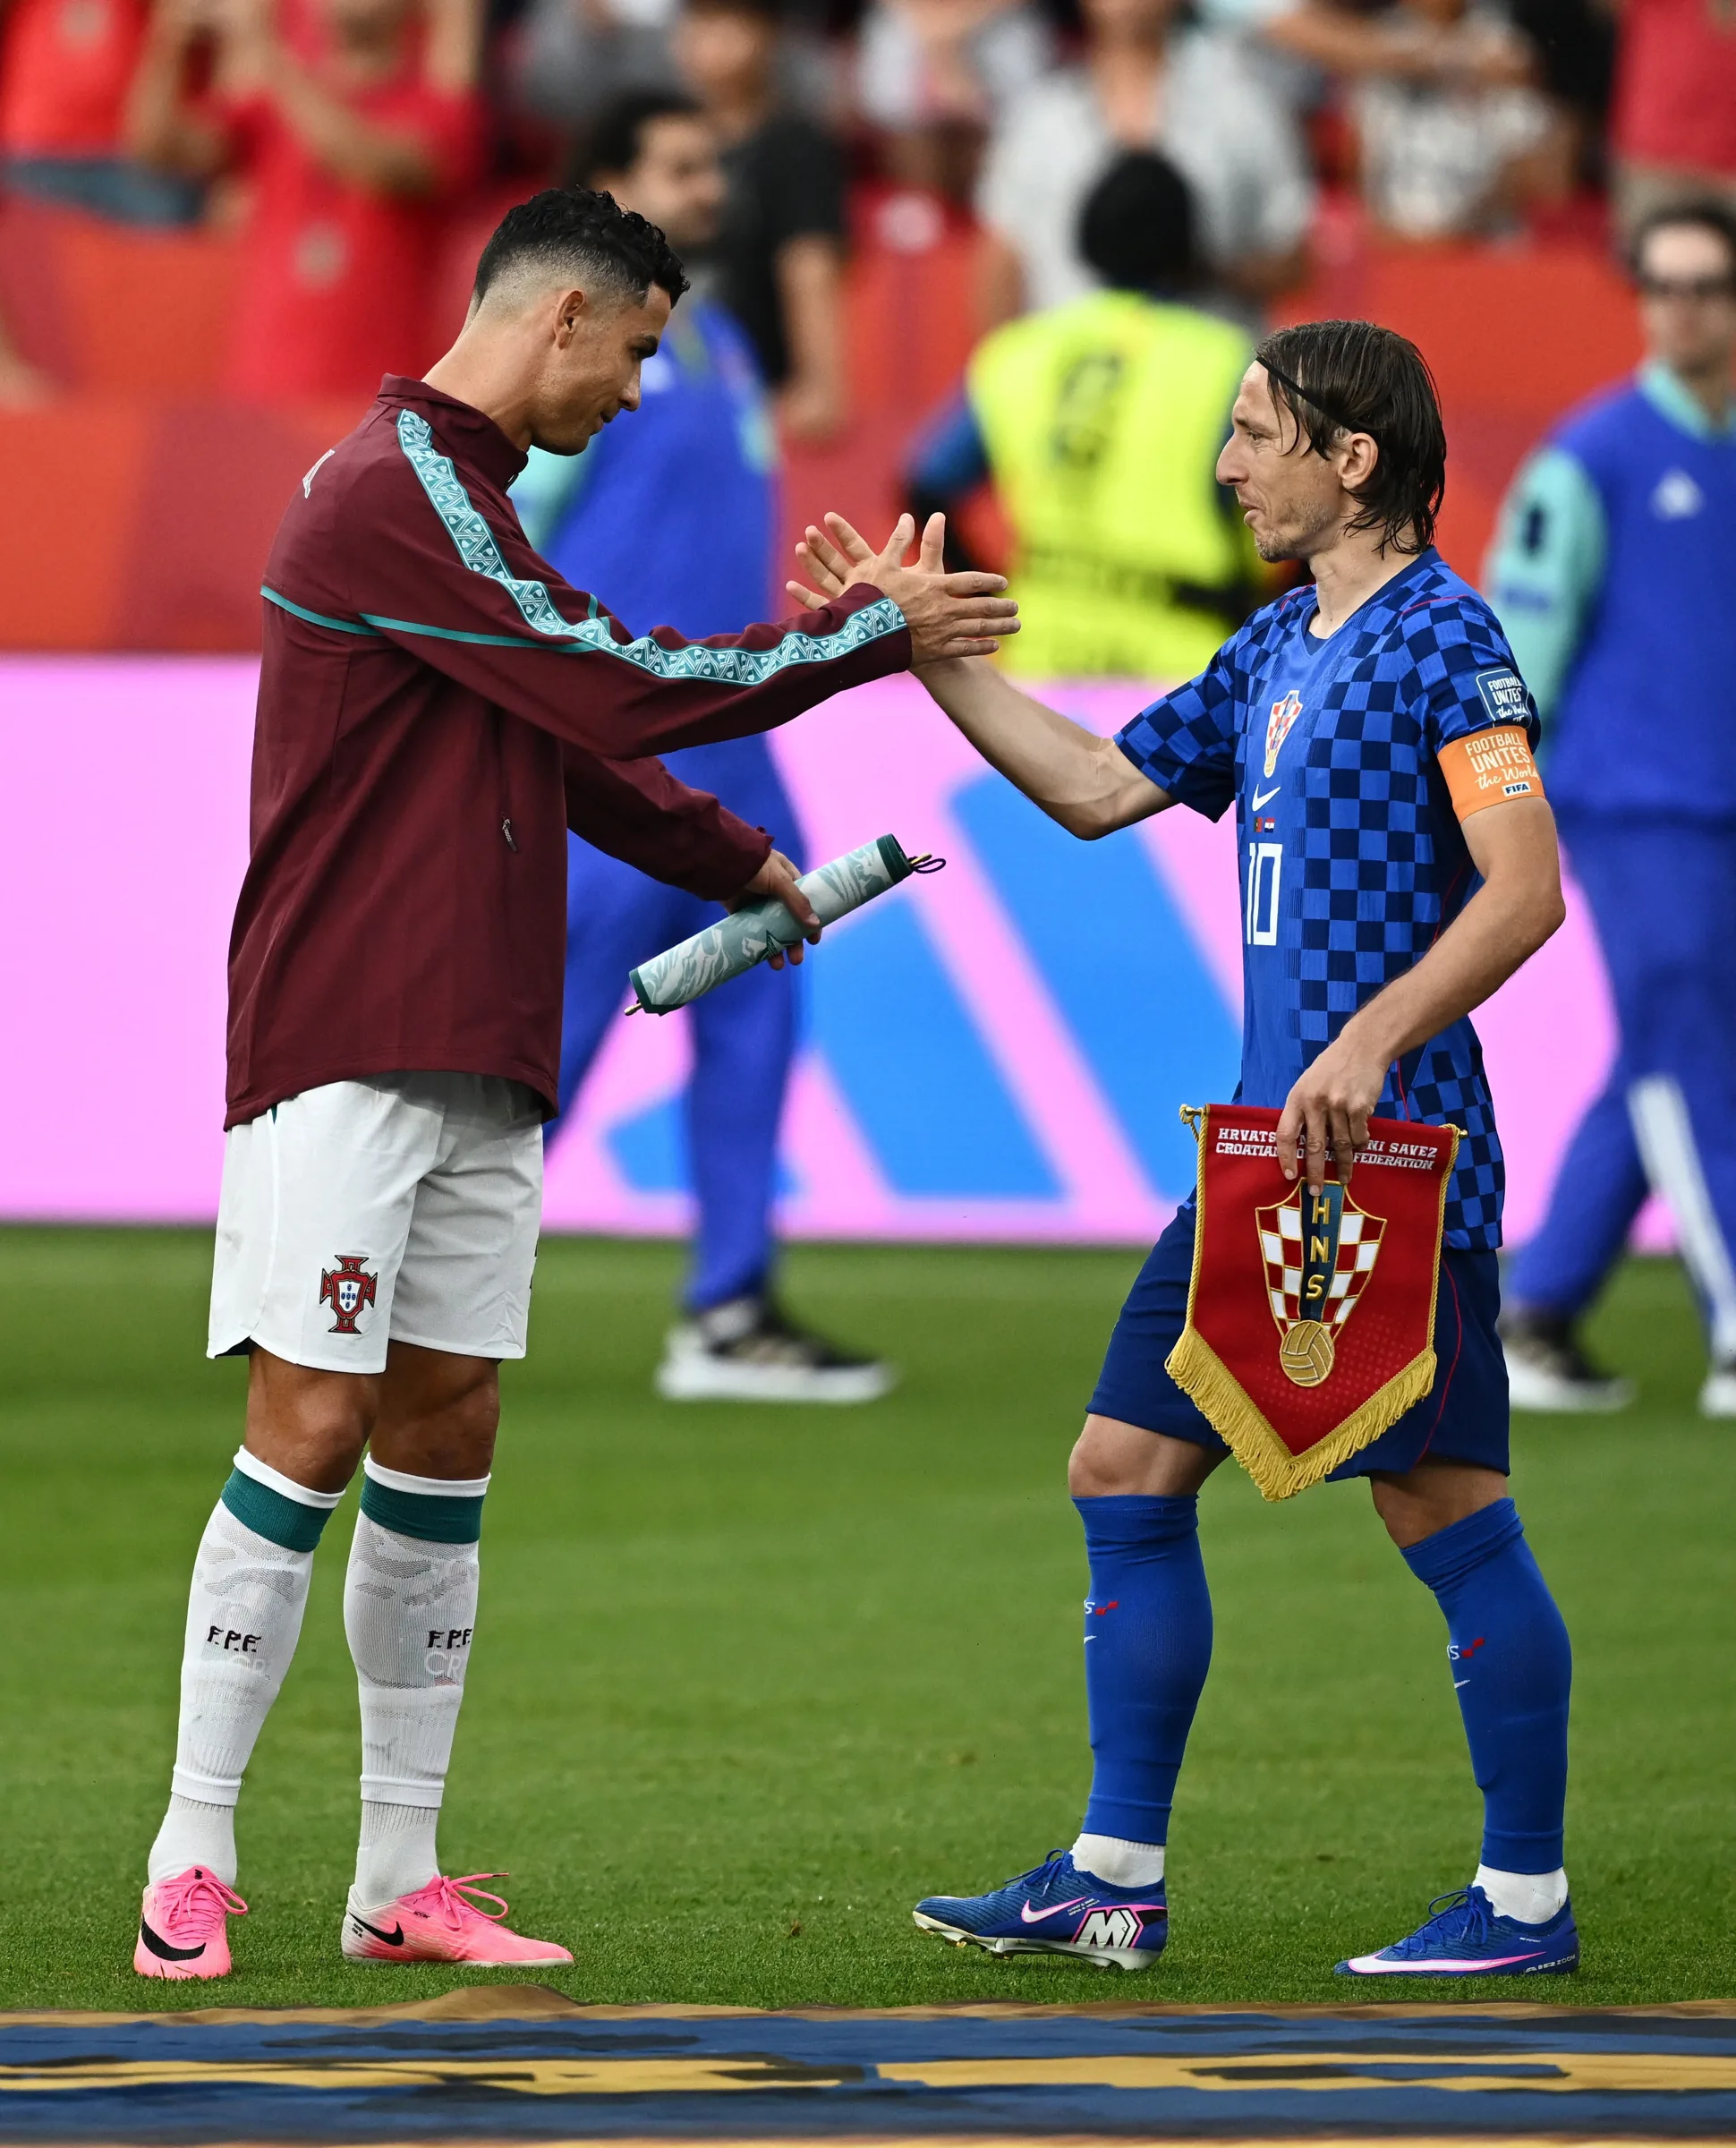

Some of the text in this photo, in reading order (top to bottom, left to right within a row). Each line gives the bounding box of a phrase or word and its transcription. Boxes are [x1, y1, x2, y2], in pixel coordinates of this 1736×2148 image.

[1487, 677, 1521, 691] FOOTBALL
[1492, 687, 1521, 705] UNITES
[1496, 706, 1512, 718] the
[1465, 733, 1523, 756] FOOTBALL
[1470, 746, 1530, 773] UNITES
[1475, 764, 1539, 789] the World
[1505, 784, 1528, 794] FIFA
[1247, 842, 1282, 946] 10
[1218, 1128, 1277, 1142] HRVATS
[1389, 1142, 1438, 1158] SAVEZ
[1353, 1152, 1434, 1170] FEDERATION
